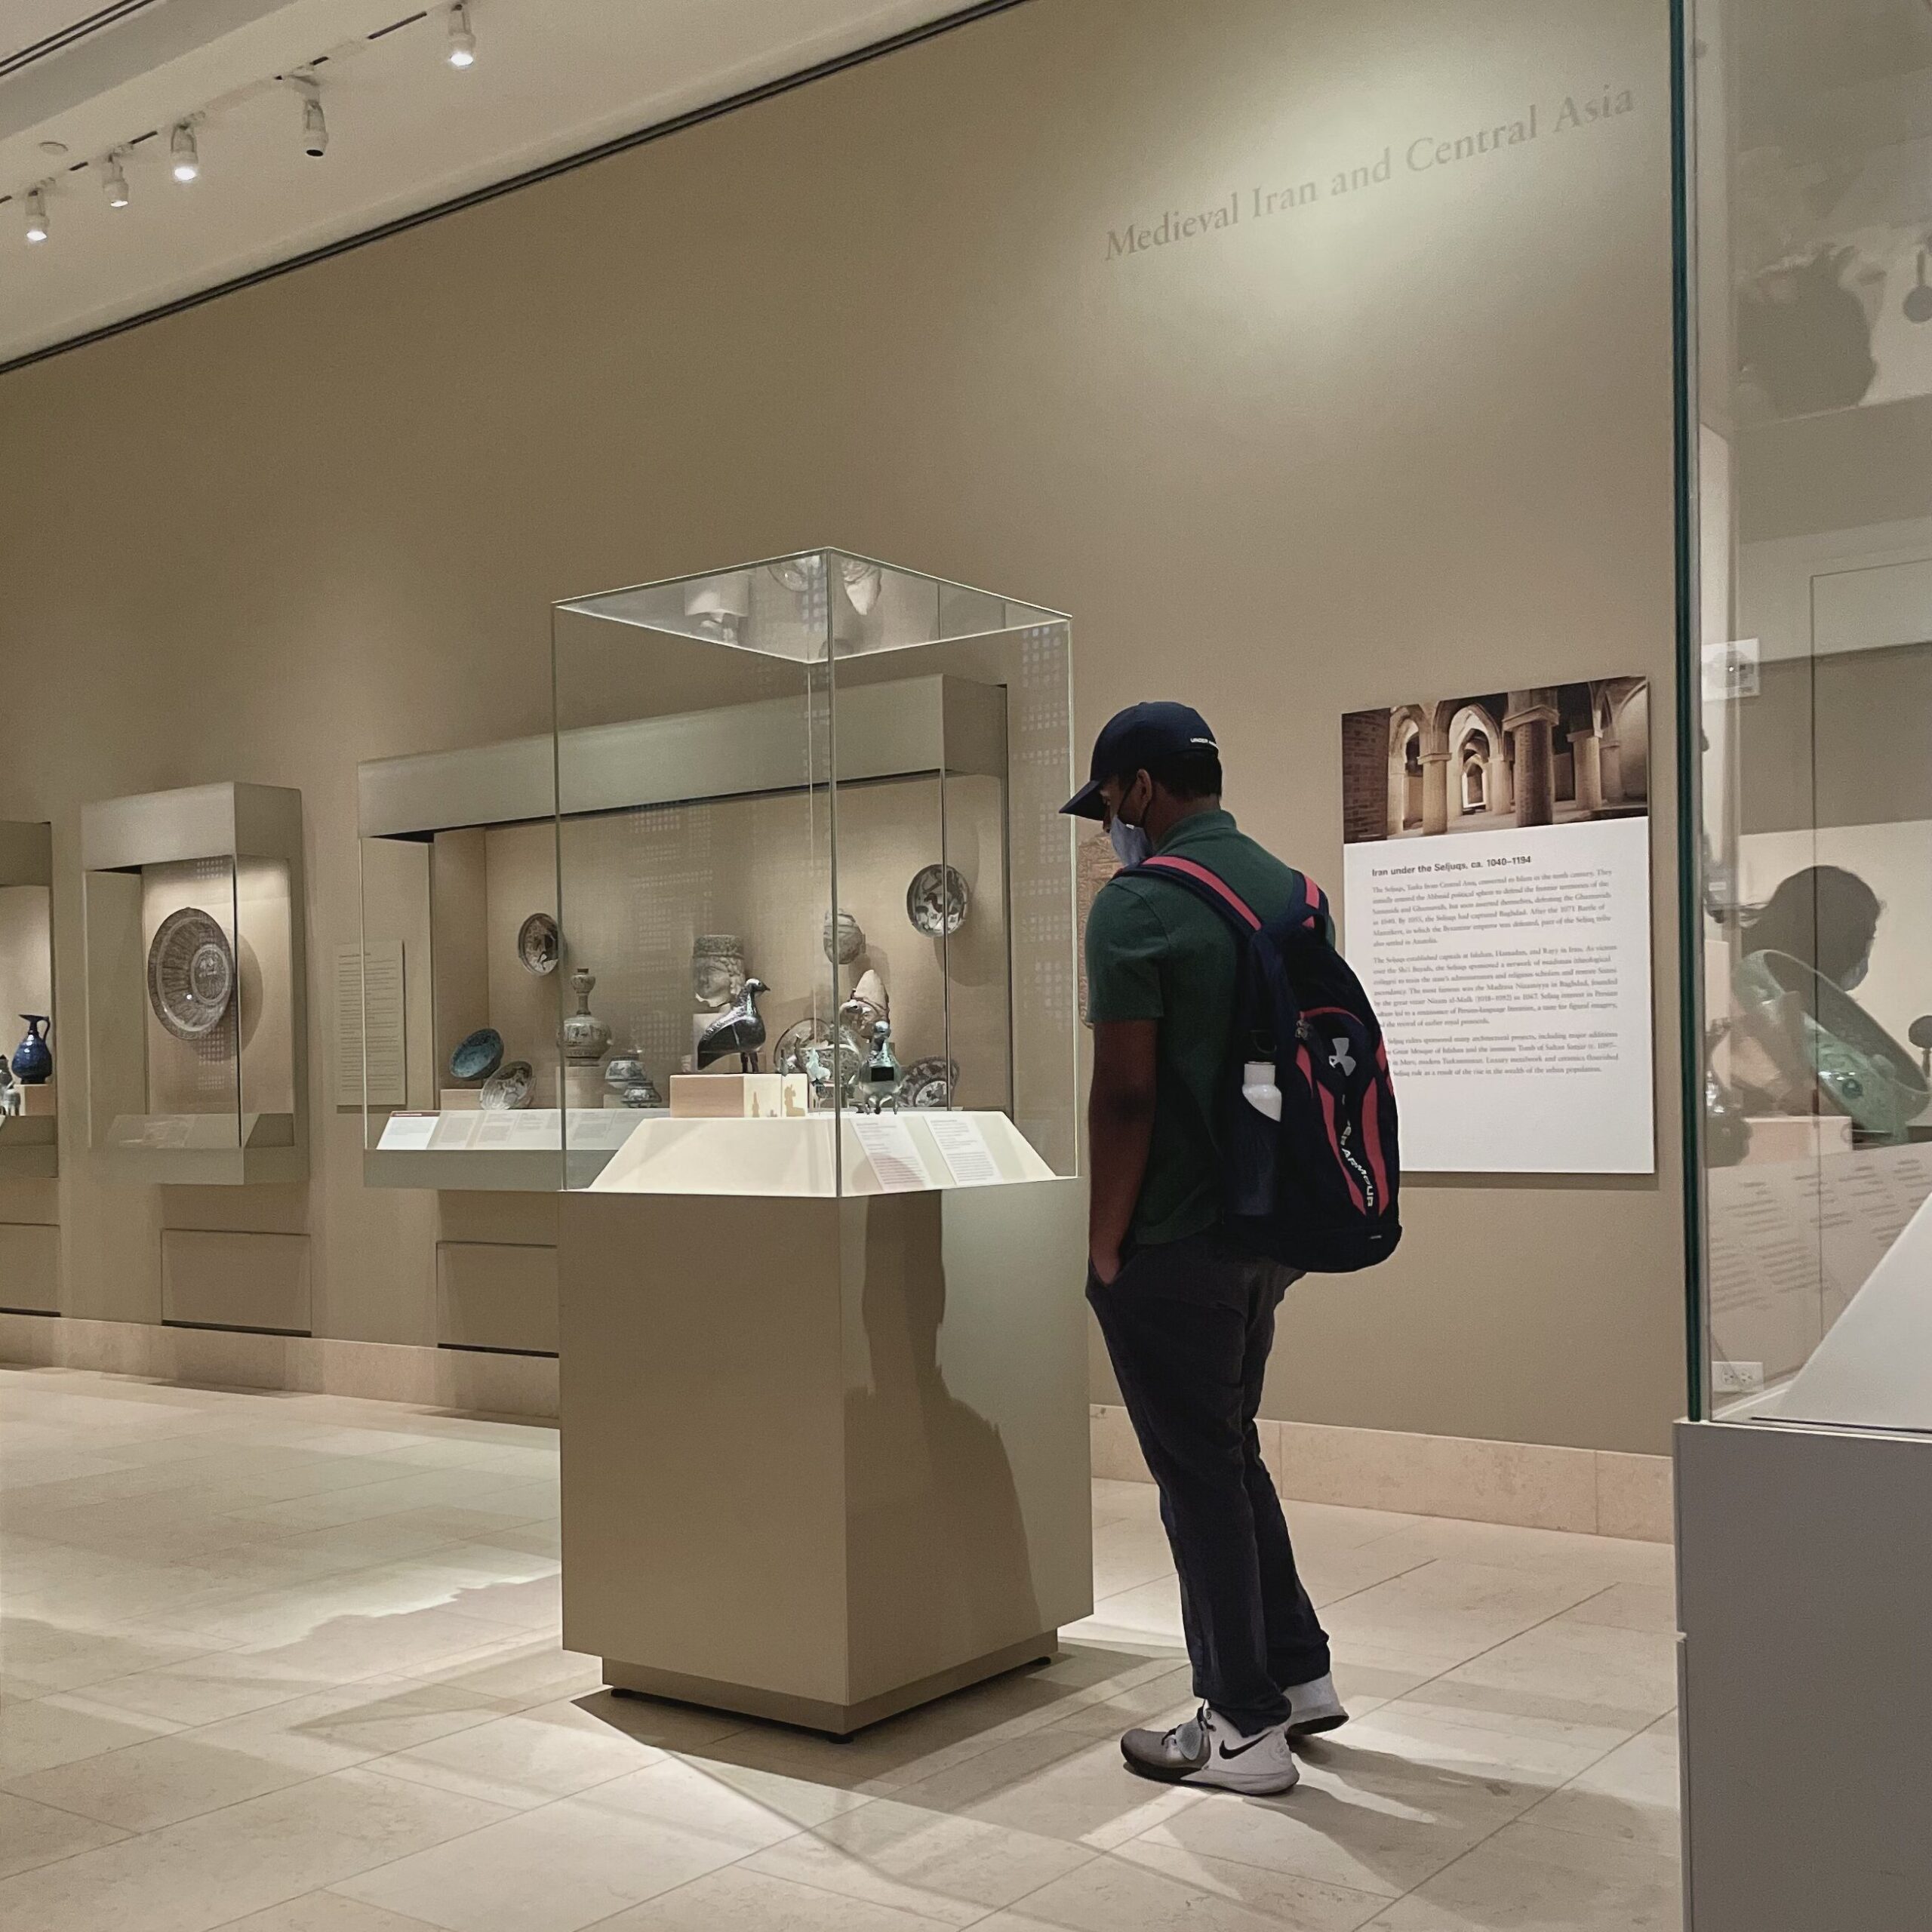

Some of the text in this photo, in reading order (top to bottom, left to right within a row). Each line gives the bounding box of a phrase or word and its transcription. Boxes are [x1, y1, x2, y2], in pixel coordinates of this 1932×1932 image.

[1105, 84, 1635, 260] Medieval Iran and Central Asia
[1391, 866, 1416, 875] under
[1418, 865, 1432, 873] the
[1435, 863, 1469, 872] Seljuqs,
